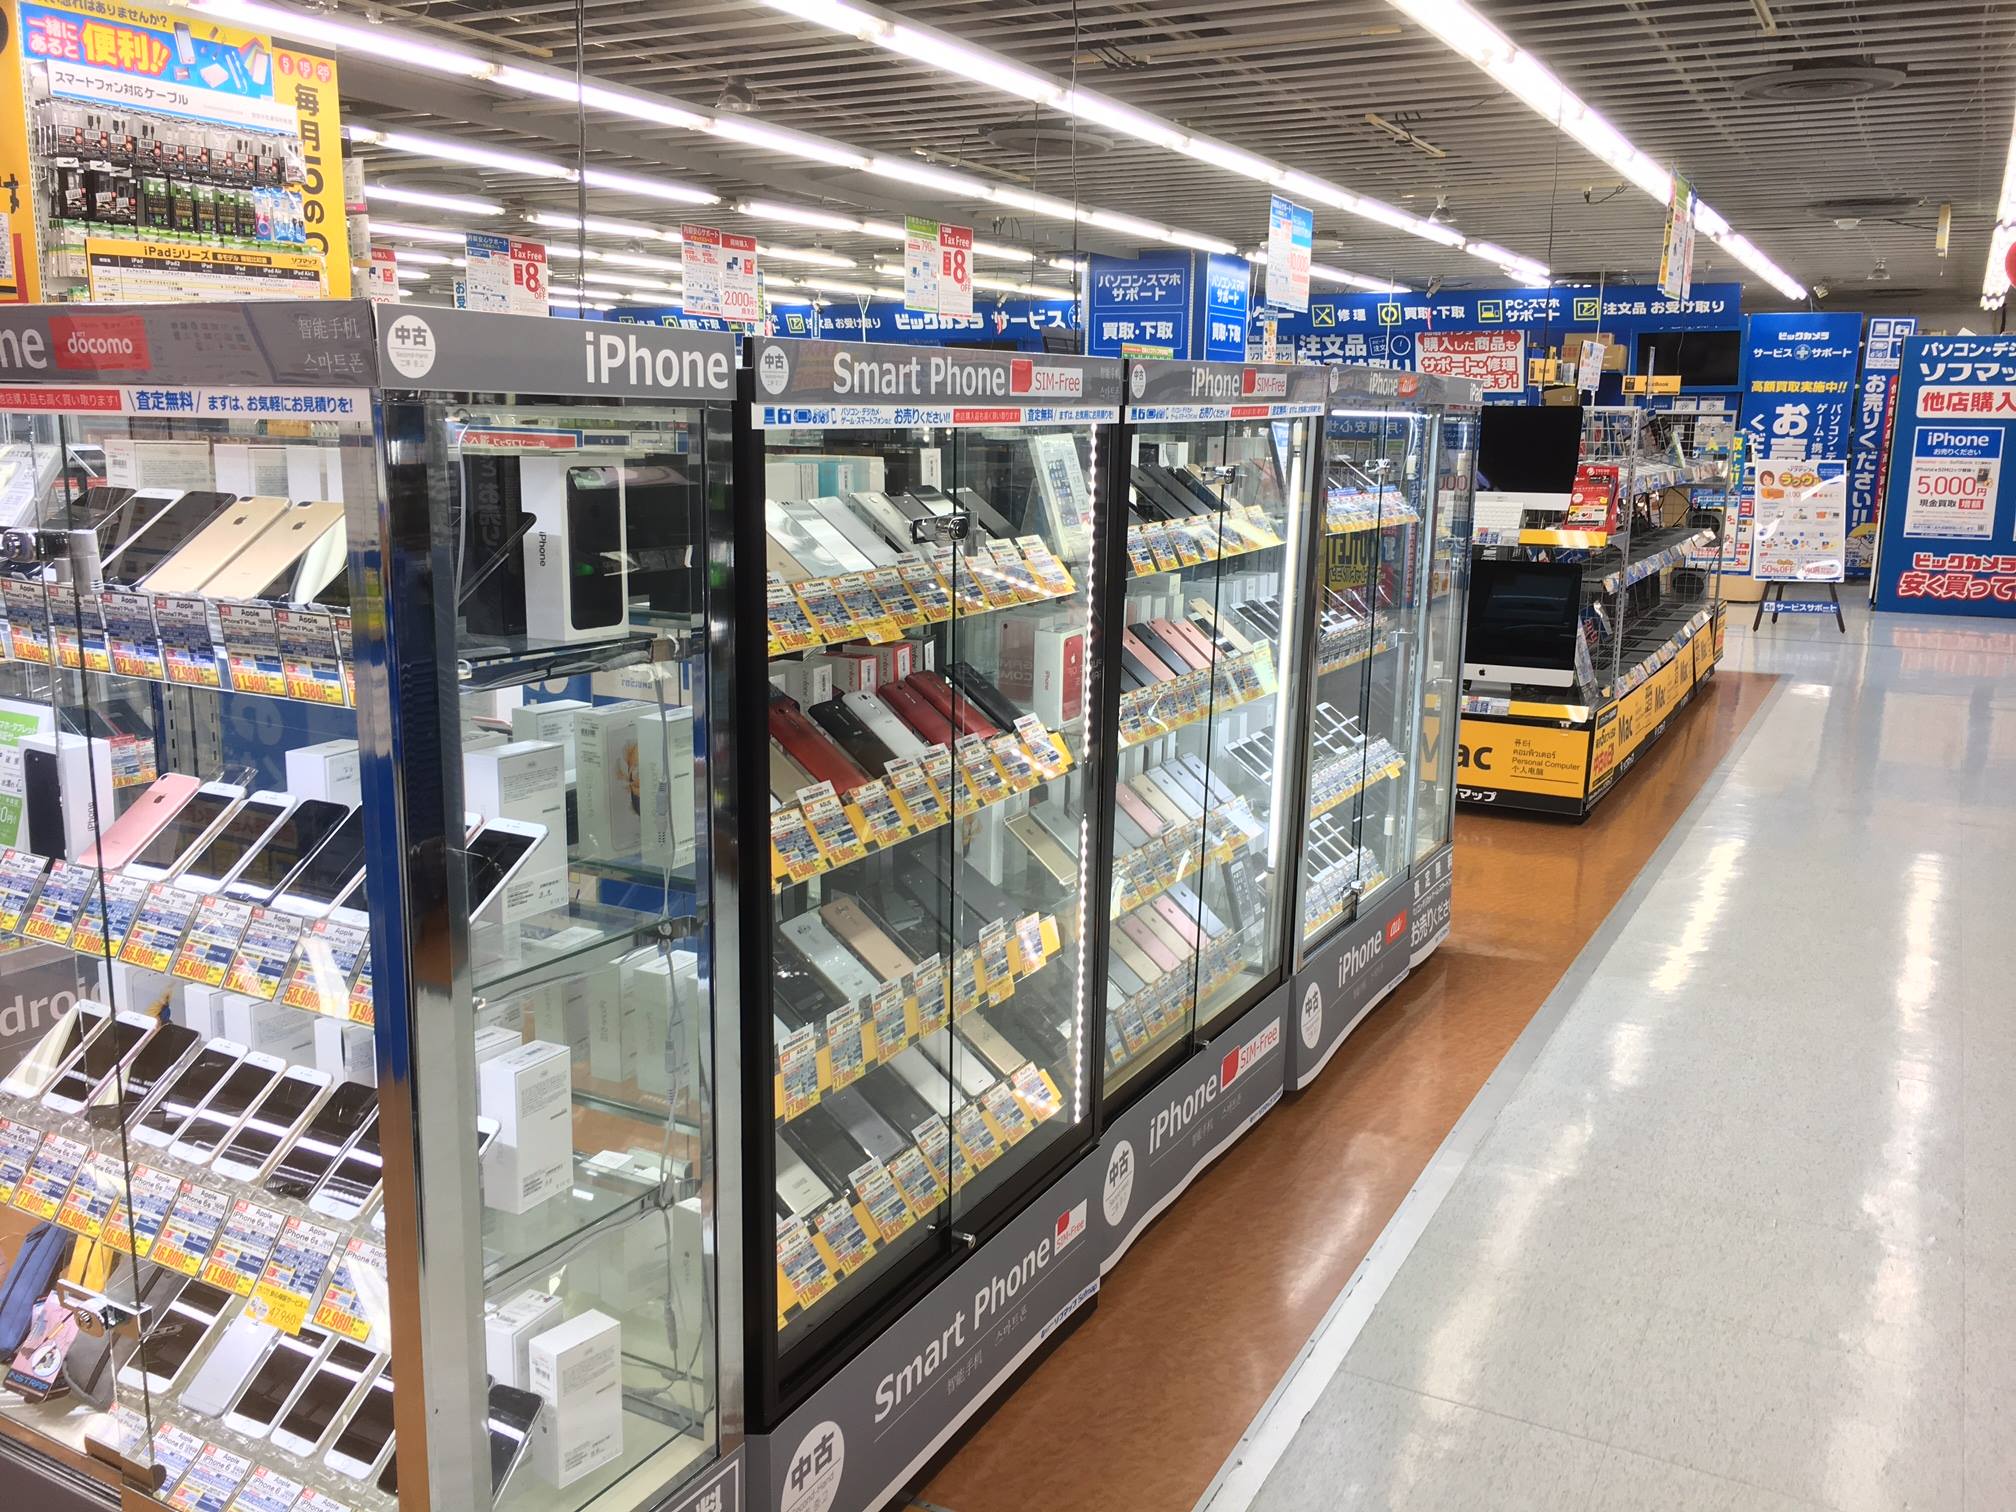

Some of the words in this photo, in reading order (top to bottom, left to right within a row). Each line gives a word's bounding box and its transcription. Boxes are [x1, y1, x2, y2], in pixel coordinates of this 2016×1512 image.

[38, 0, 168, 27] 忘れはありませんか?
[30, 33, 80, 59] あると
[82, 19, 171, 75] 便利!!
[55, 70, 189, 106] スマートフォン対応ケーブル
[944, 234, 955, 245] Tax
[956, 237, 970, 248] Free
[144, 246, 210, 261] iPadシリーズ
[514, 248, 526, 259] Tax
[527, 250, 543, 261] Free
[1098, 274, 1181, 287] パソコン・スマホ
[1112, 287, 1166, 302] サポート
[1216, 290, 1240, 304] サポート
[1505, 299, 1560, 308] PC・スマホ
[1602, 302, 1647, 315] 注文品
[1650, 301, 1725, 314] お受け取り
[992, 310, 1066, 330] サービス
[1337, 309, 1367, 322] 修理
[1404, 306, 1466, 320] 買取・下取
[1506, 309, 1560, 322] サポート
[299, 316, 361, 339] 智能手机
[394, 325, 427, 346] 中古
[1102, 321, 1173, 340] 買取・下取
[67, 332, 133, 354] docomo
[1424, 337, 1516, 352] 購入した商品も
[1778, 332, 1829, 341] ビックカメラ
[1299, 334, 1367, 356] 注文品
[1753, 349, 1793, 358] サービス
[1811, 348, 1852, 358] サポート
[303, 351, 364, 374] 스마트폰
[585, 331, 729, 390] iPhone
[764, 353, 784, 370] 中古
[1423, 357, 1517, 373] サポート・修理
[833, 352, 922, 395] Smart
[930, 356, 1005, 396] Phone
[1035, 372, 1080, 392] SIM-Free
[1191, 367, 1239, 397] iPhone
[1256, 376, 1285, 393] SIM-Free
[1369, 373, 1398, 397] iPhone
[1751, 381, 1848, 393] 高額買取実施中!!
[136, 390, 194, 411] 査定無料
[208, 394, 353, 413] まずは、お気軽にお見積りを!
[1922, 391, 2016, 412] 他店購入
[1027, 408, 1054, 422] 査定無料
[1927, 432, 1989, 447] iPhone
[1852, 375, 1886, 527] お売りください!!
[1919, 499, 1956, 508] 現金買取
[539, 531, 548, 567] iPhone
[1914, 553, 2016, 572] ビックカメラ
[1899, 573, 2016, 600] 安く買って
[1776, 603, 1837, 613] サービスサポート
[1618, 715, 1633, 746] Mac
[1512, 757, 1543, 767] Personal
[1544, 760, 1581, 771] Computer
[1456, 788, 1497, 802] マップ
[1338, 929, 1382, 988] iPhone
[1305, 990, 1319, 1018] 中古
[1149, 1074, 1217, 1155] iPhone
[1240, 1027, 1278, 1069] SIM-Free
[1109, 1149, 1129, 1188] 中古
[233, 1211, 256, 1226] iPhone
[256, 1208, 273, 1220] Apple
[285, 1228, 310, 1244] iPhone
[309, 1226, 327, 1237] Apple
[1056, 1219, 1084, 1248] SIM-Free
[345, 1251, 370, 1266] iPhone
[874, 1310, 965, 1425] Smart
[973, 1237, 1050, 1332] Phone
[158, 1433, 178, 1448] iPhone
[178, 1432, 193, 1443] Apple
[203, 1455, 224, 1469] iPhone
[223, 1453, 239, 1465] Apple
[791, 1432, 834, 1492] 中古
[253, 1477, 274, 1493] iPhone
[273, 1476, 290, 1488] Apple
